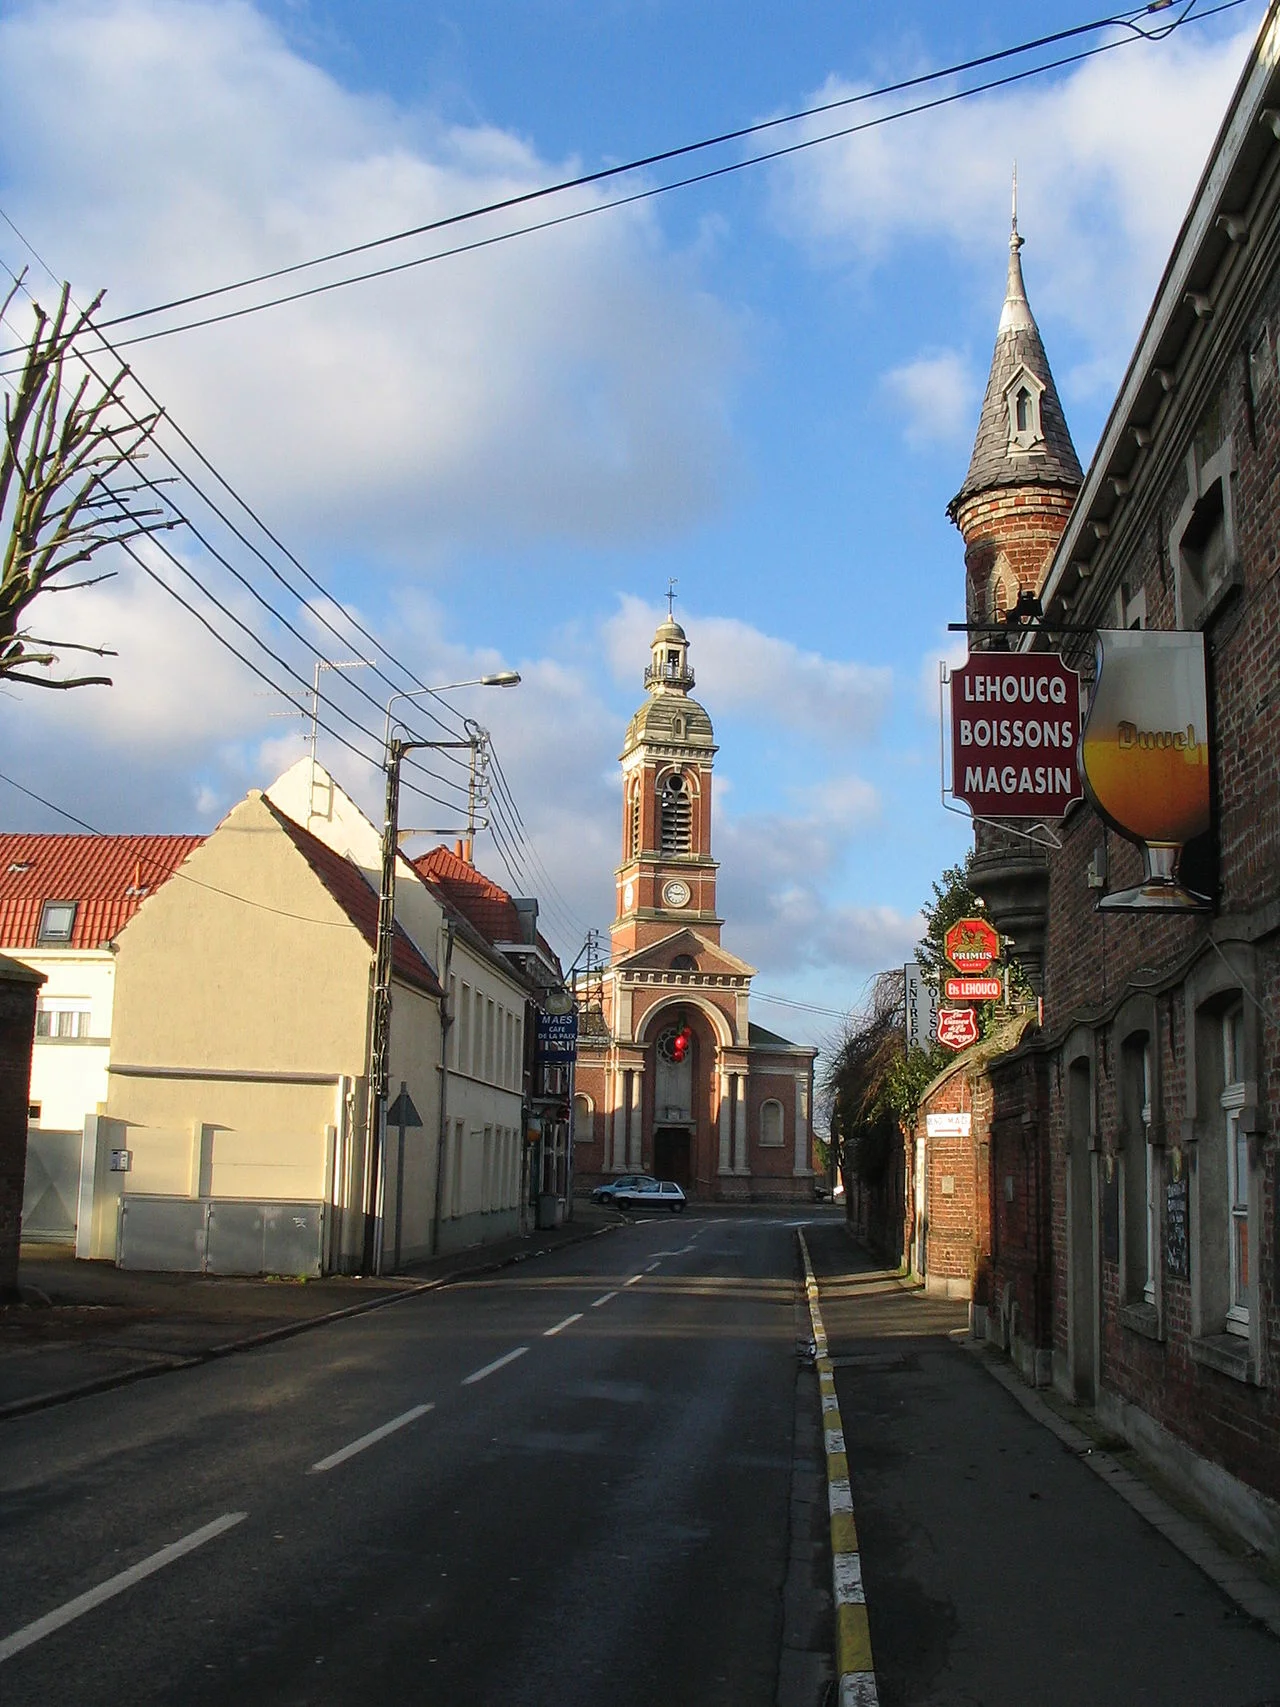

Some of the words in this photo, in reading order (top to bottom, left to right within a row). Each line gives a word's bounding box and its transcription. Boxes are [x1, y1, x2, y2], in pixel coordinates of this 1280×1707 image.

[964, 675, 1067, 704] LEHOUCQ
[960, 720, 1073, 748] BOISSONS
[1117, 720, 1197, 751] Duvel
[964, 766, 1071, 794] MAGASIN
[952, 952, 993, 960] PRIMUS
[961, 983, 998, 995] LEHOUCQ
[541, 1015, 573, 1025] MAES
